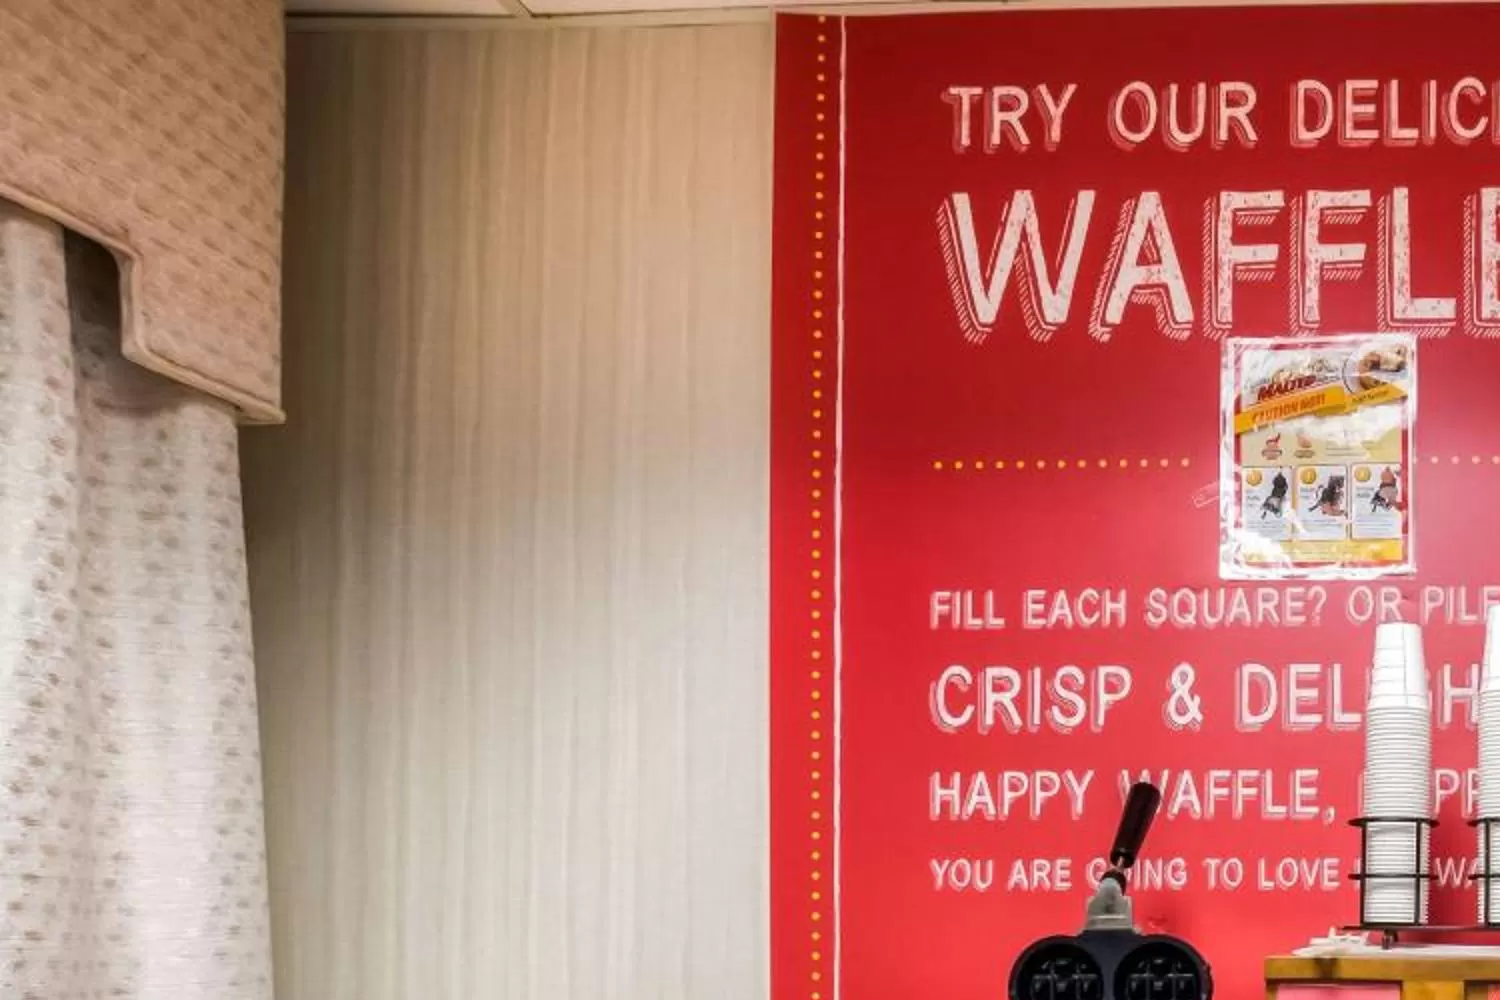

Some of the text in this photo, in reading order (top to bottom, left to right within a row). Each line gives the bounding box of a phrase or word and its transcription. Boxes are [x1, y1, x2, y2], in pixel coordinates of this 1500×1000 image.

[942, 83, 1077, 152] TRY
[1107, 80, 1258, 152] OUR
[930, 590, 1006, 630] FILL
[1022, 588, 1127, 629] EACH
[1145, 586, 1328, 629] SQUARE?
[1346, 585, 1402, 625] OR
[930, 664, 1132, 734] CRISP
[1163, 662, 1204, 732] &
[930, 769, 1094, 821] HAPPY
[930, 858, 994, 890] YOU
[1007, 858, 1073, 890] ARE
[1085, 857, 1188, 890] GING
[1203, 857, 1243, 890] TO
[1257, 857, 1341, 889] LOVE
